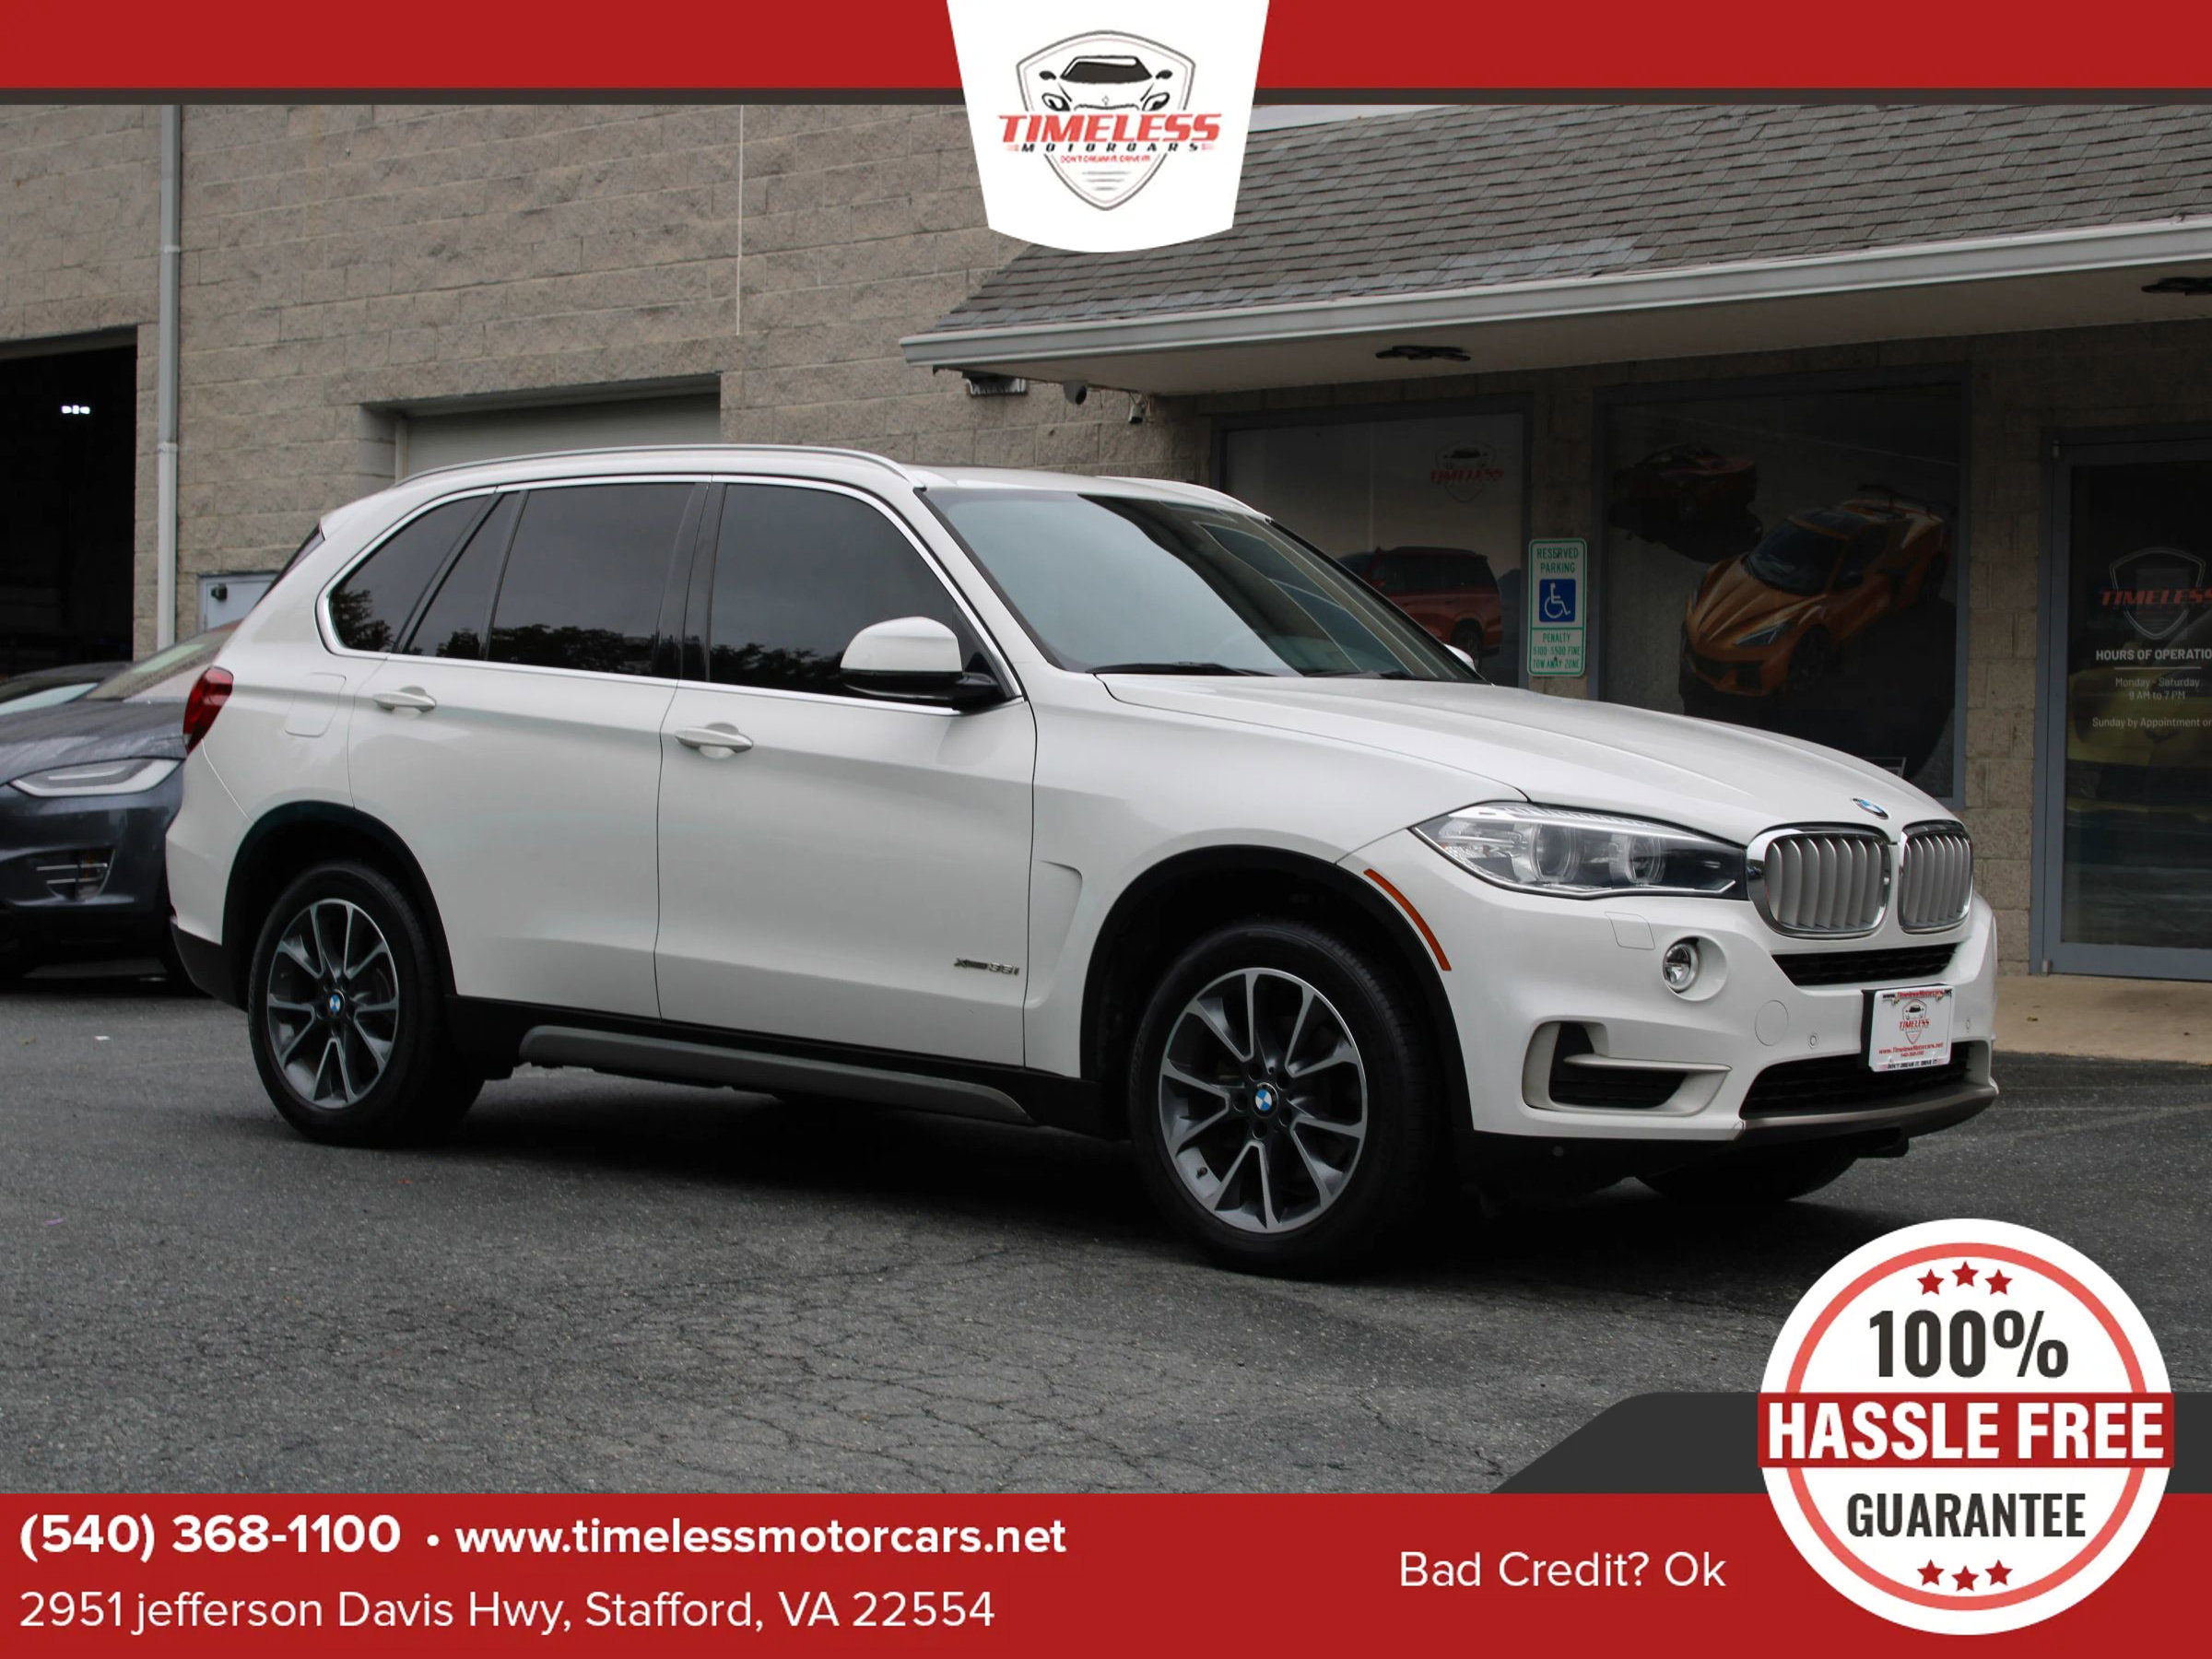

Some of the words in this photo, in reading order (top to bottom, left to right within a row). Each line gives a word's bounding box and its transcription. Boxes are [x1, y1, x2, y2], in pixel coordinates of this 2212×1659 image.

[1536, 547, 1579, 559] RESERVED
[1540, 562, 1576, 574] PARKING
[1542, 631, 1571, 642] PENALTY
[2095, 649, 2136, 662] HOURS
[2137, 649, 2153, 661] OF
[2115, 677, 2150, 689] Monday
[2158, 677, 2201, 688] Saturday
[2136, 691, 2150, 700] AM
[2152, 691, 2162, 700] to
[2171, 690, 2186, 700] PM
[2092, 718, 2125, 729] Sunday
[2127, 718, 2138, 729] by
[2139, 717, 2201, 728] Appointment
